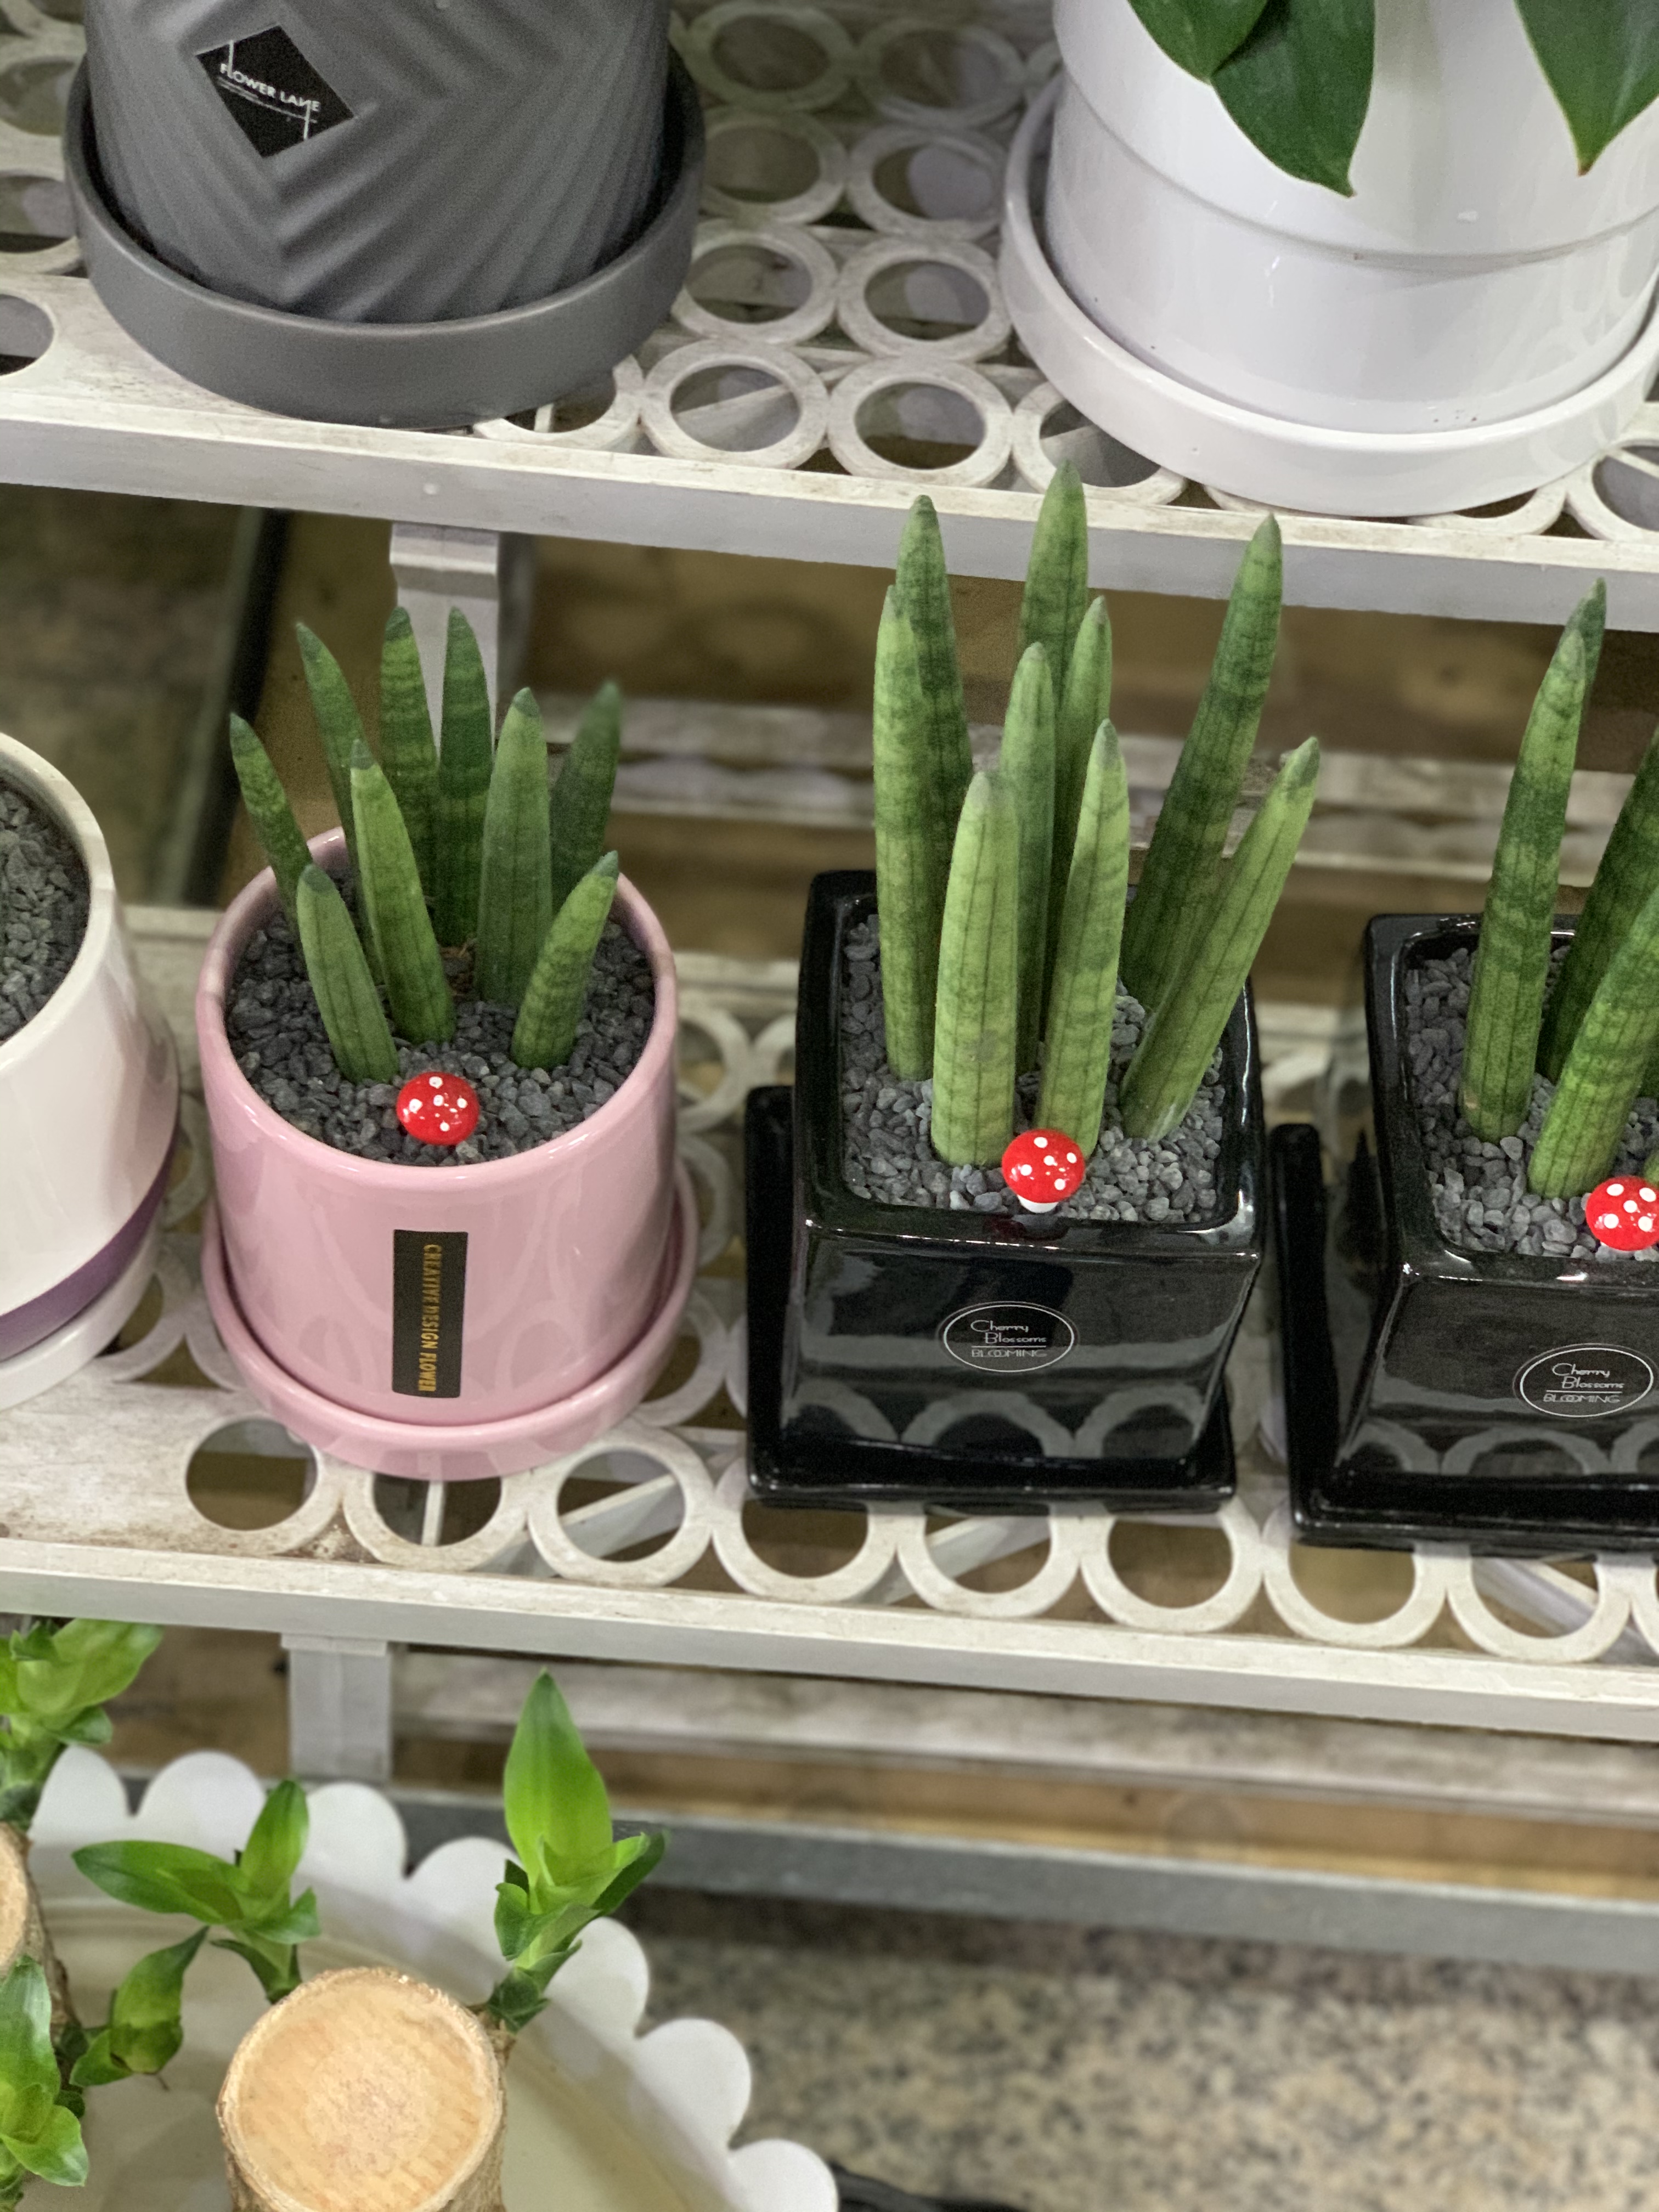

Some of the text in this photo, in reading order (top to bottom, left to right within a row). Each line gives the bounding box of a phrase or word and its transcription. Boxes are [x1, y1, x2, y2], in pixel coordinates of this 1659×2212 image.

[219, 40, 276, 98] FLOWER
[417, 1244, 442, 1392] CREATIVE DESIGN FLOWER
[970, 1319, 1029, 1333] Cherry
[983, 1331, 1047, 1344] Blossoms
[971, 1349, 1048, 1357] BLOOMING
[1551, 1362, 1610, 1378] Cherry
[1561, 1375, 1626, 1389] Blossoms
[1543, 1393, 1621, 1403] BLOOMING
